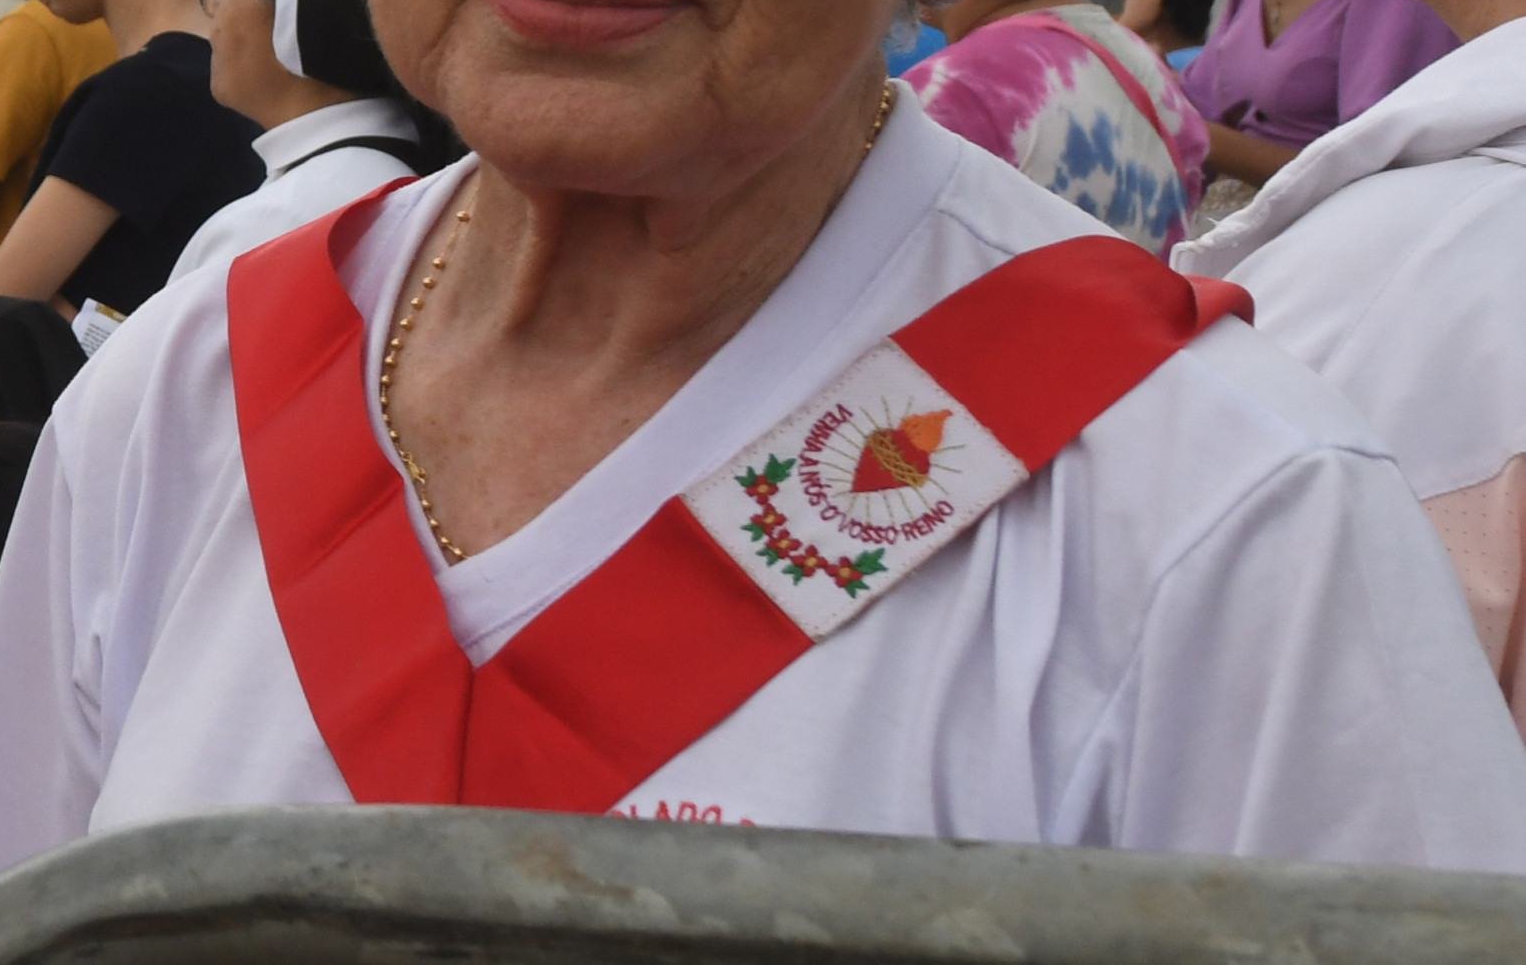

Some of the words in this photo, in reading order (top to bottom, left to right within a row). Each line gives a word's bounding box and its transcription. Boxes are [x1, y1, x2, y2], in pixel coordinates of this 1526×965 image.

[804, 403, 854, 453] VENHA
[799, 451, 820, 467] A
[820, 505, 840, 521] O
[837, 511, 901, 545] VOSSO
[900, 500, 955, 542] REINO
